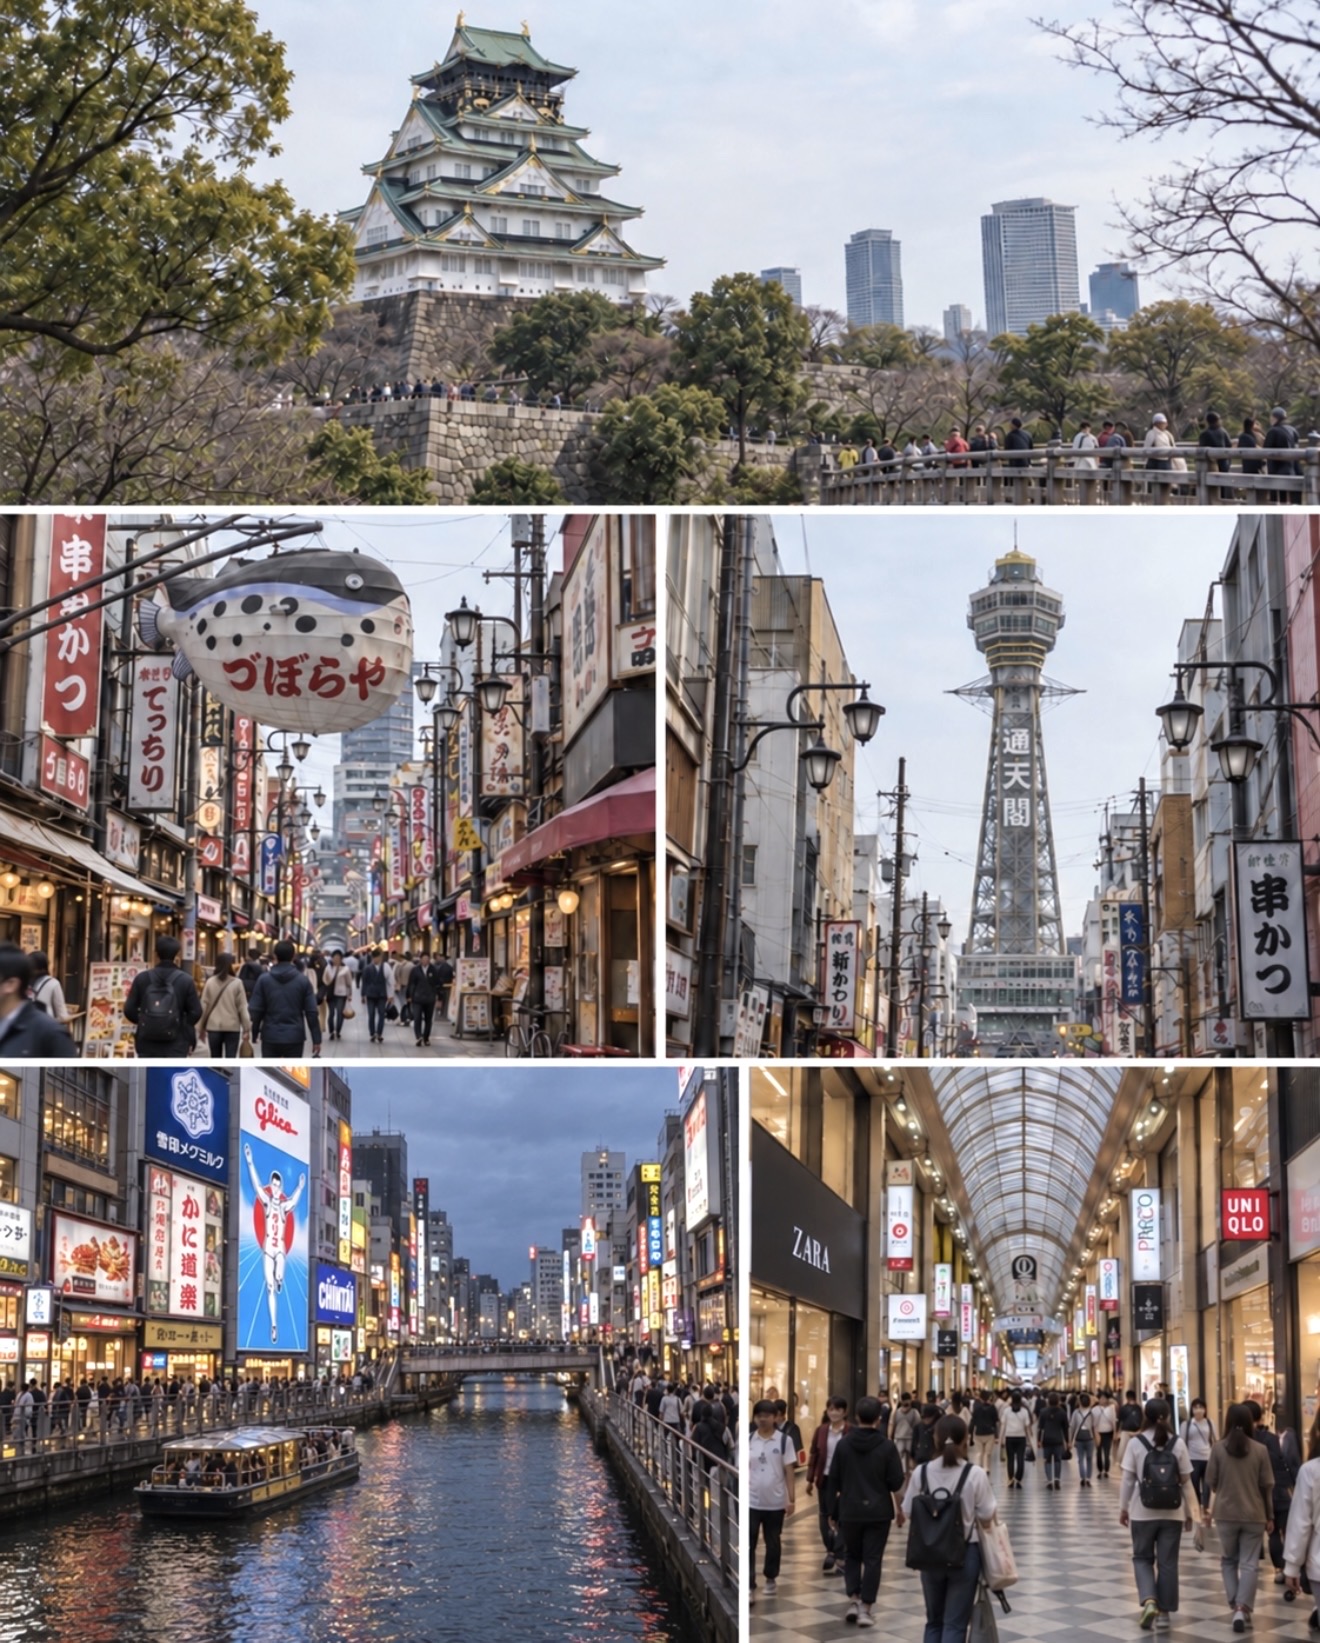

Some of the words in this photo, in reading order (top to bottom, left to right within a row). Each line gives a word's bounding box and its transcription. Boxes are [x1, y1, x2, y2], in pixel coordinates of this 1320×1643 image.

[222, 652, 386, 701] づぼらや
[141, 686, 168, 792] てっちり
[1250, 872, 1292, 995] 串かつ
[254, 1097, 298, 1136] Glico
[1137, 1193, 1155, 1252] PARCO
[1227, 1198, 1261, 1213] UNI
[1227, 1216, 1264, 1235] QLO
[180, 1194, 200, 1310] かに道楽
[792, 1225, 831, 1274] ZARA
